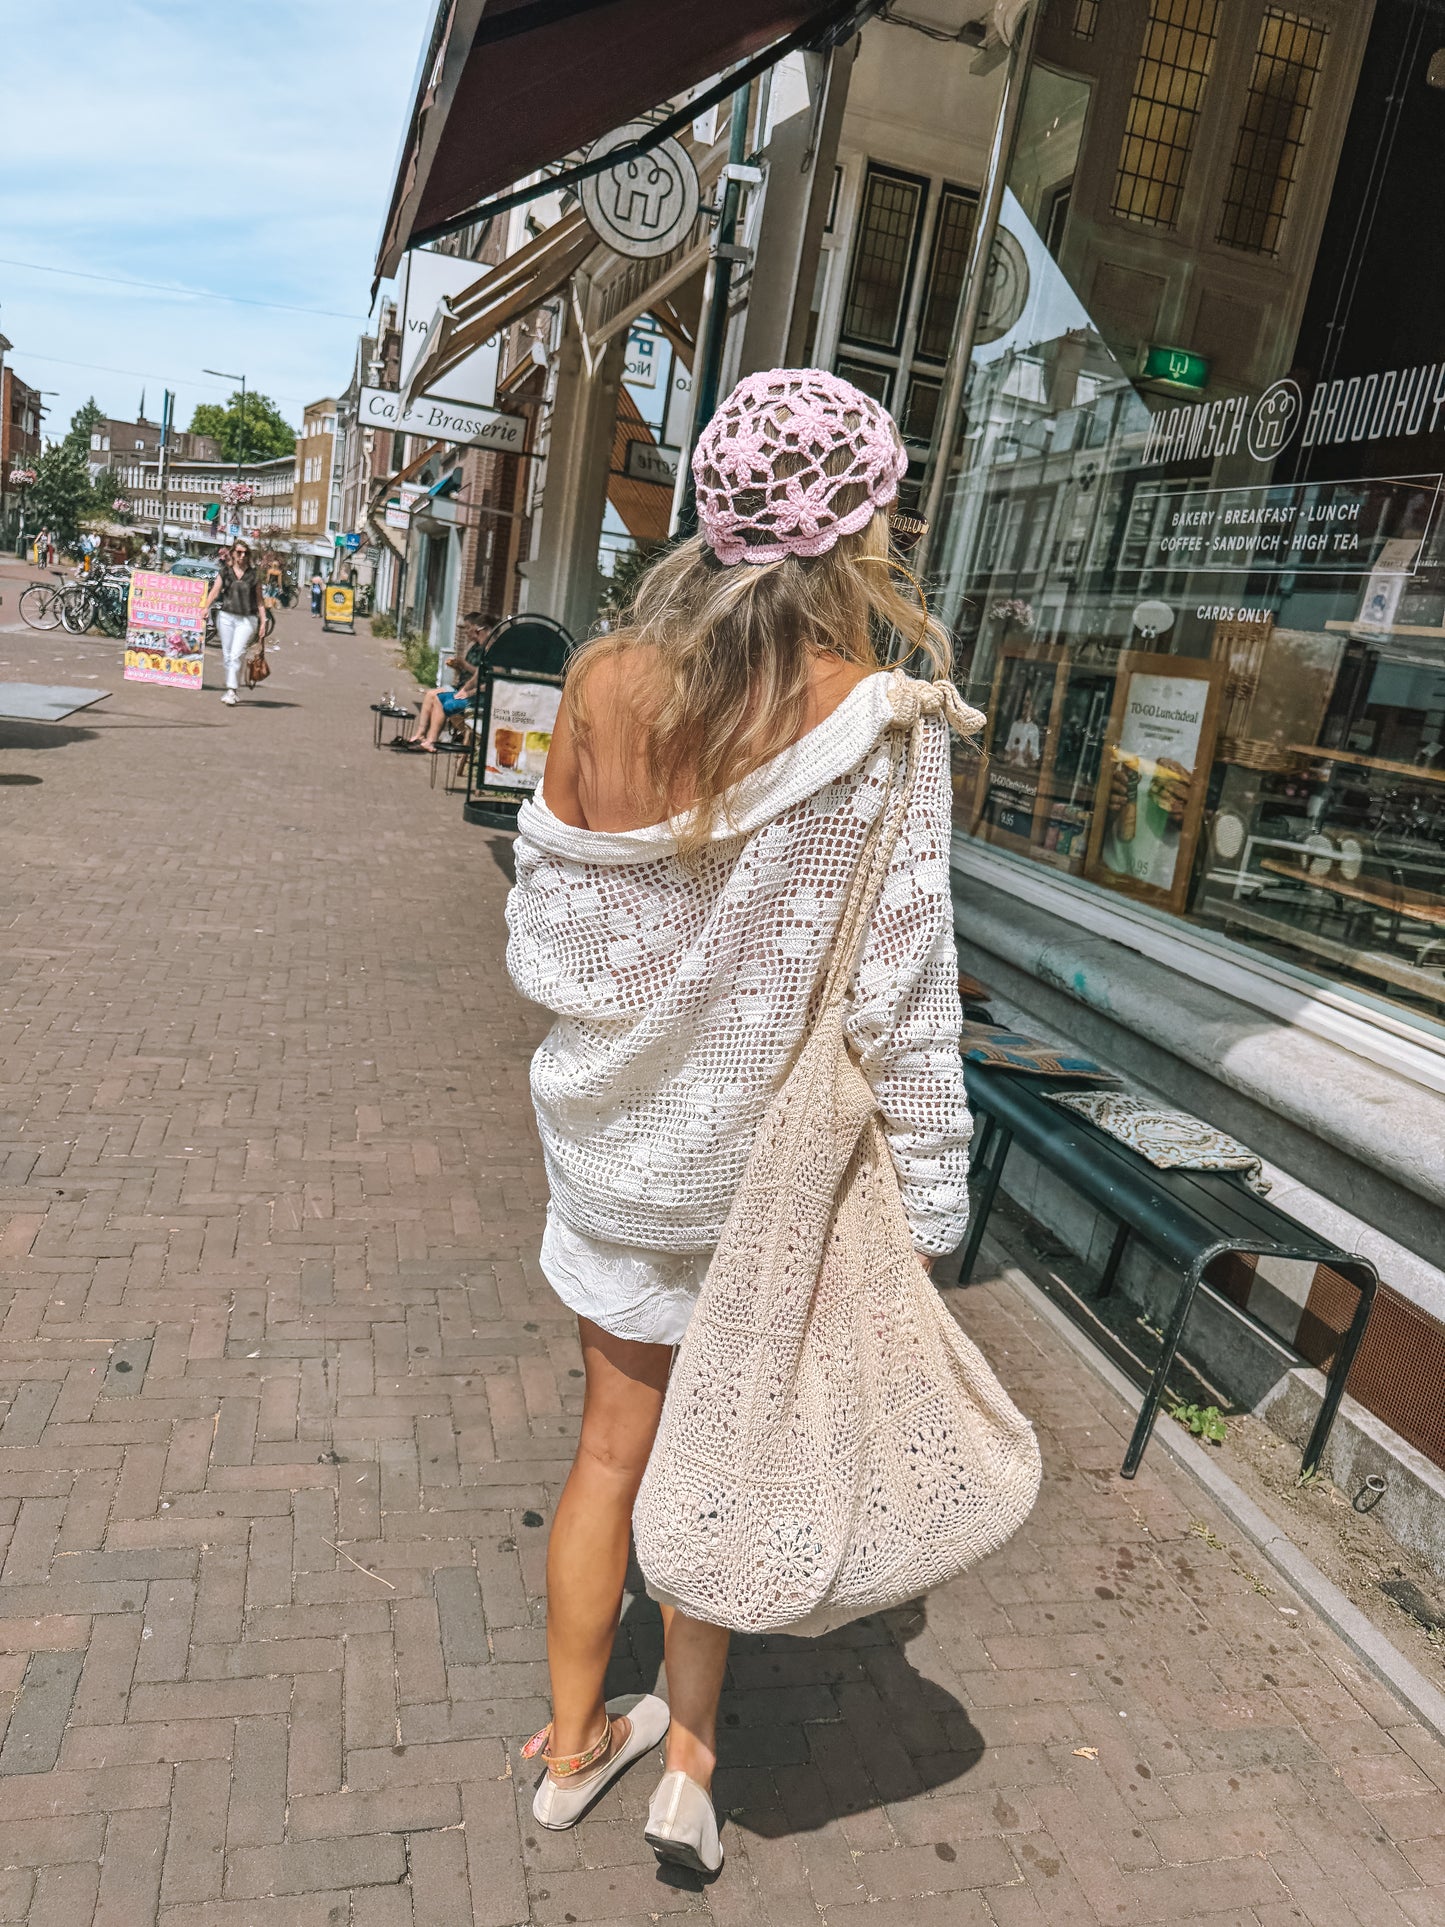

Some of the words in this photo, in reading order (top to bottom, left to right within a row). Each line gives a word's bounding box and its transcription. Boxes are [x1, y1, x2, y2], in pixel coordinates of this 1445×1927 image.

[427, 407, 518, 442] Brasserie
[1141, 395, 1249, 466] VLAAMSCH
[1301, 361, 1445, 448] BROODHUY
[1171, 510, 1215, 527] BAKERY
[1223, 506, 1297, 525] BREAKFAST
[1307, 503, 1360, 522] LUNCH
[1160, 536, 1203, 552] COFFEE
[1212, 535, 1280, 551] SANDWICH
[1291, 534, 1328, 551] HIGH
[1334, 533, 1359, 550] TEA
[133, 572, 205, 596] KERMIS
[1196, 605, 1235, 621] CARDS
[1237, 607, 1271, 624] ONLY
